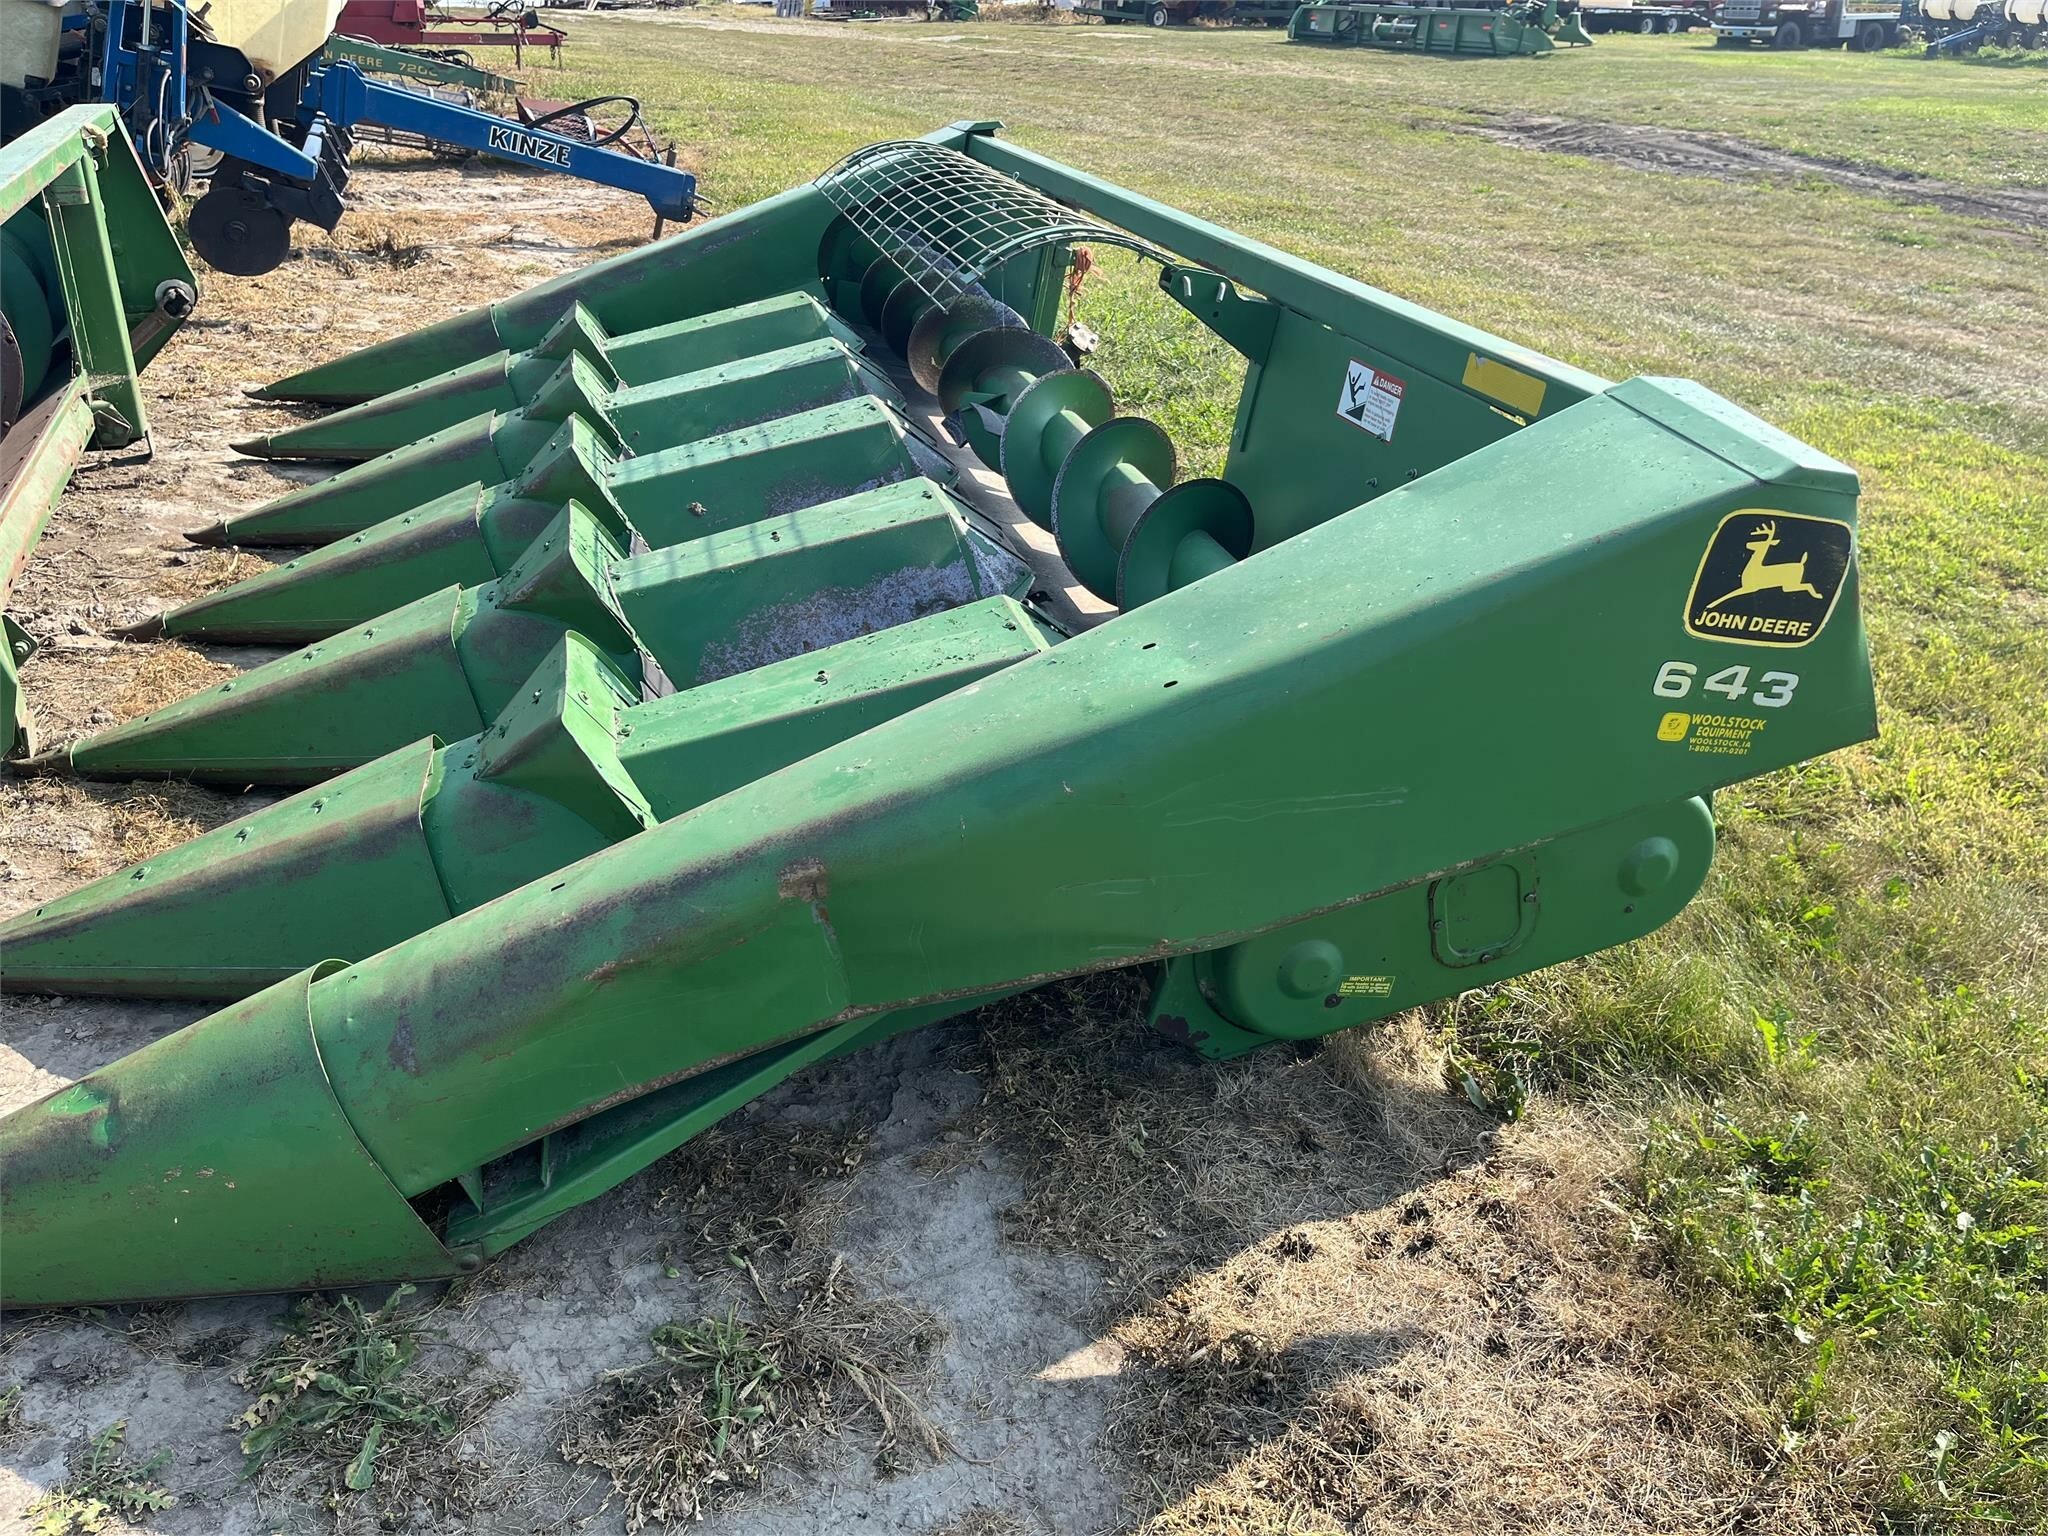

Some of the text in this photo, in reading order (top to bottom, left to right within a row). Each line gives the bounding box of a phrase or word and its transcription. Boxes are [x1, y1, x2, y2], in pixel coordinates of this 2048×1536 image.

[340, 53, 383, 67] DEERE
[489, 125, 571, 168] KINZE
[1379, 378, 1403, 397] DANGER
[1695, 611, 1812, 637] JOHN DEERE
[1653, 661, 1800, 708] 643
[1692, 714, 1766, 730] WOOLSTOCK
[1696, 727, 1752, 739] EQUIPMENT
